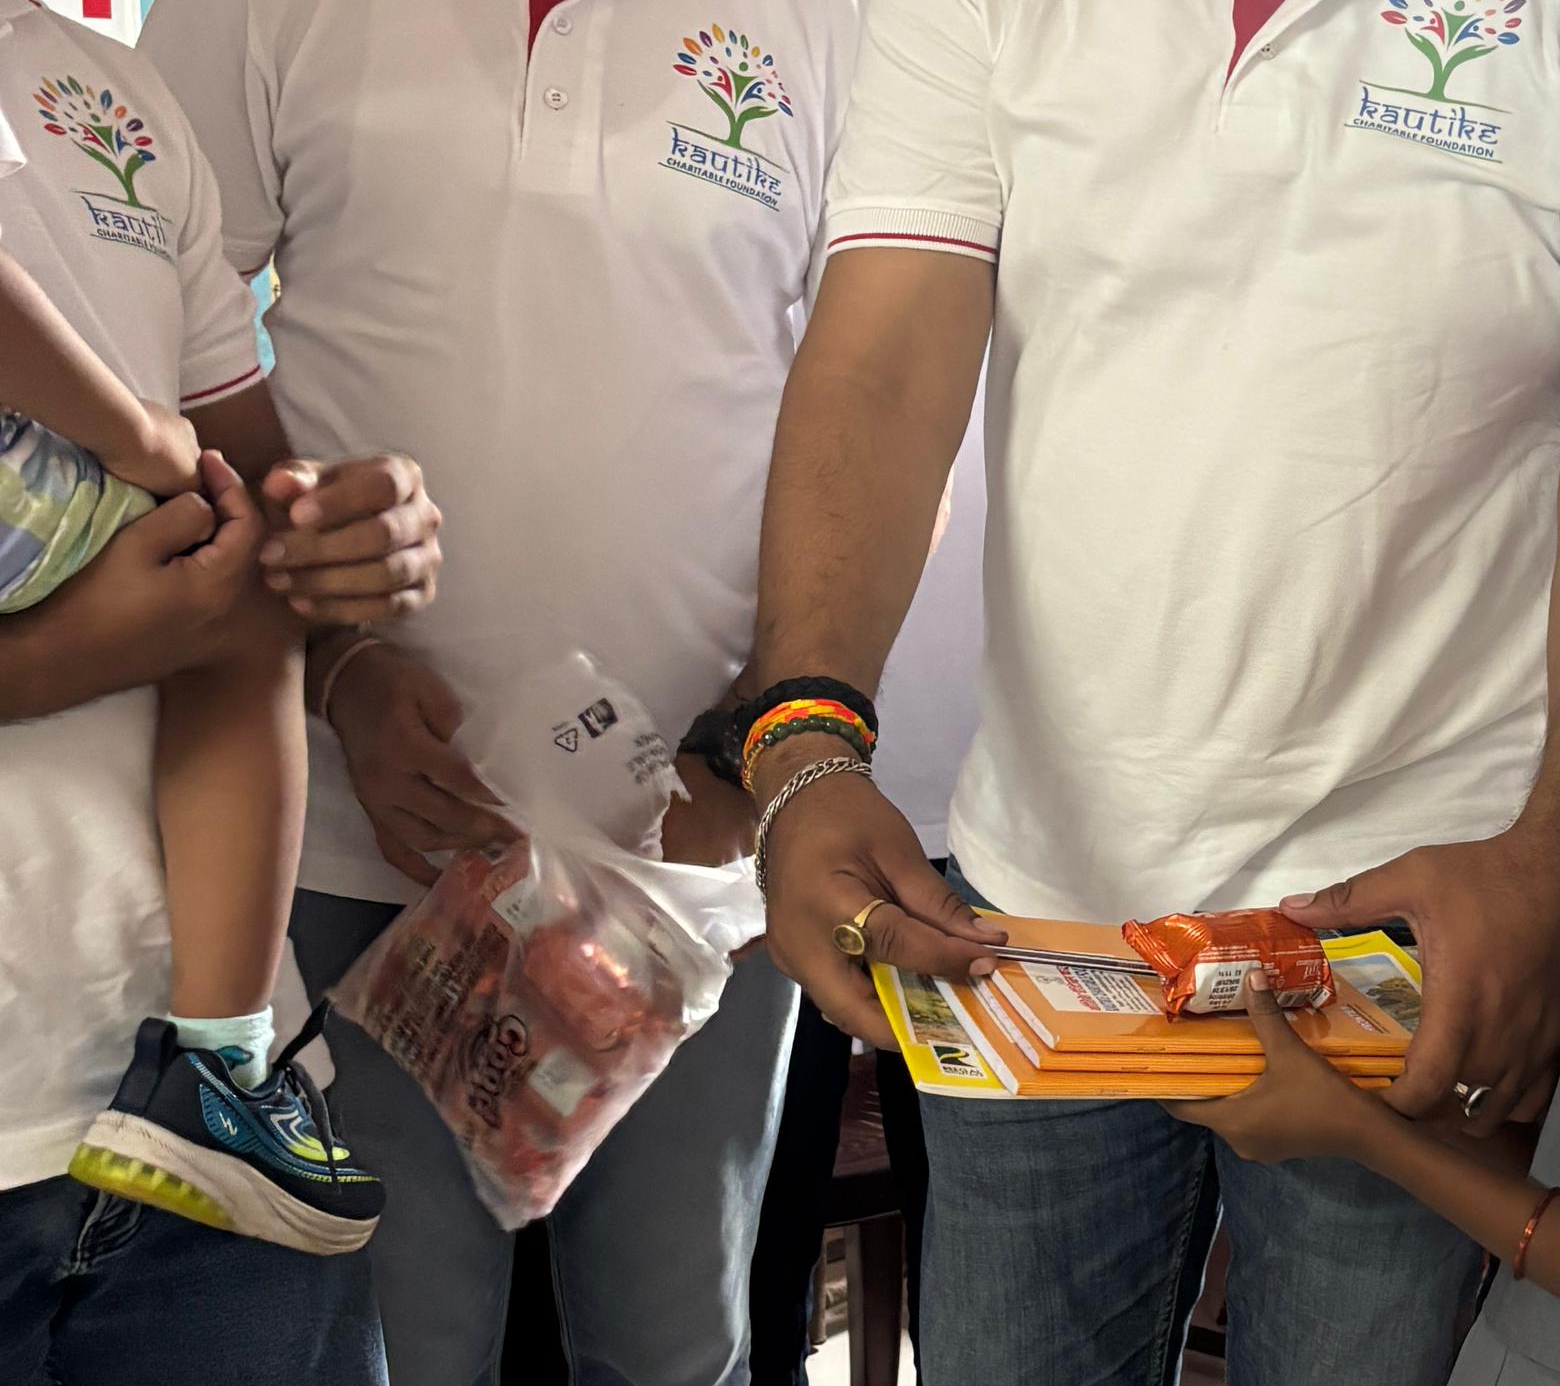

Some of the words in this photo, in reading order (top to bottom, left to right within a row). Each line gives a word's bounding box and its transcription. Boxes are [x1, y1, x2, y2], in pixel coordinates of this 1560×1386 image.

[1353, 117, 1418, 141] CHARITABLE
[1420, 134, 1495, 158] FOUNDATION
[1359, 86, 1502, 145] kautike
[672, 126, 782, 197] kautike
